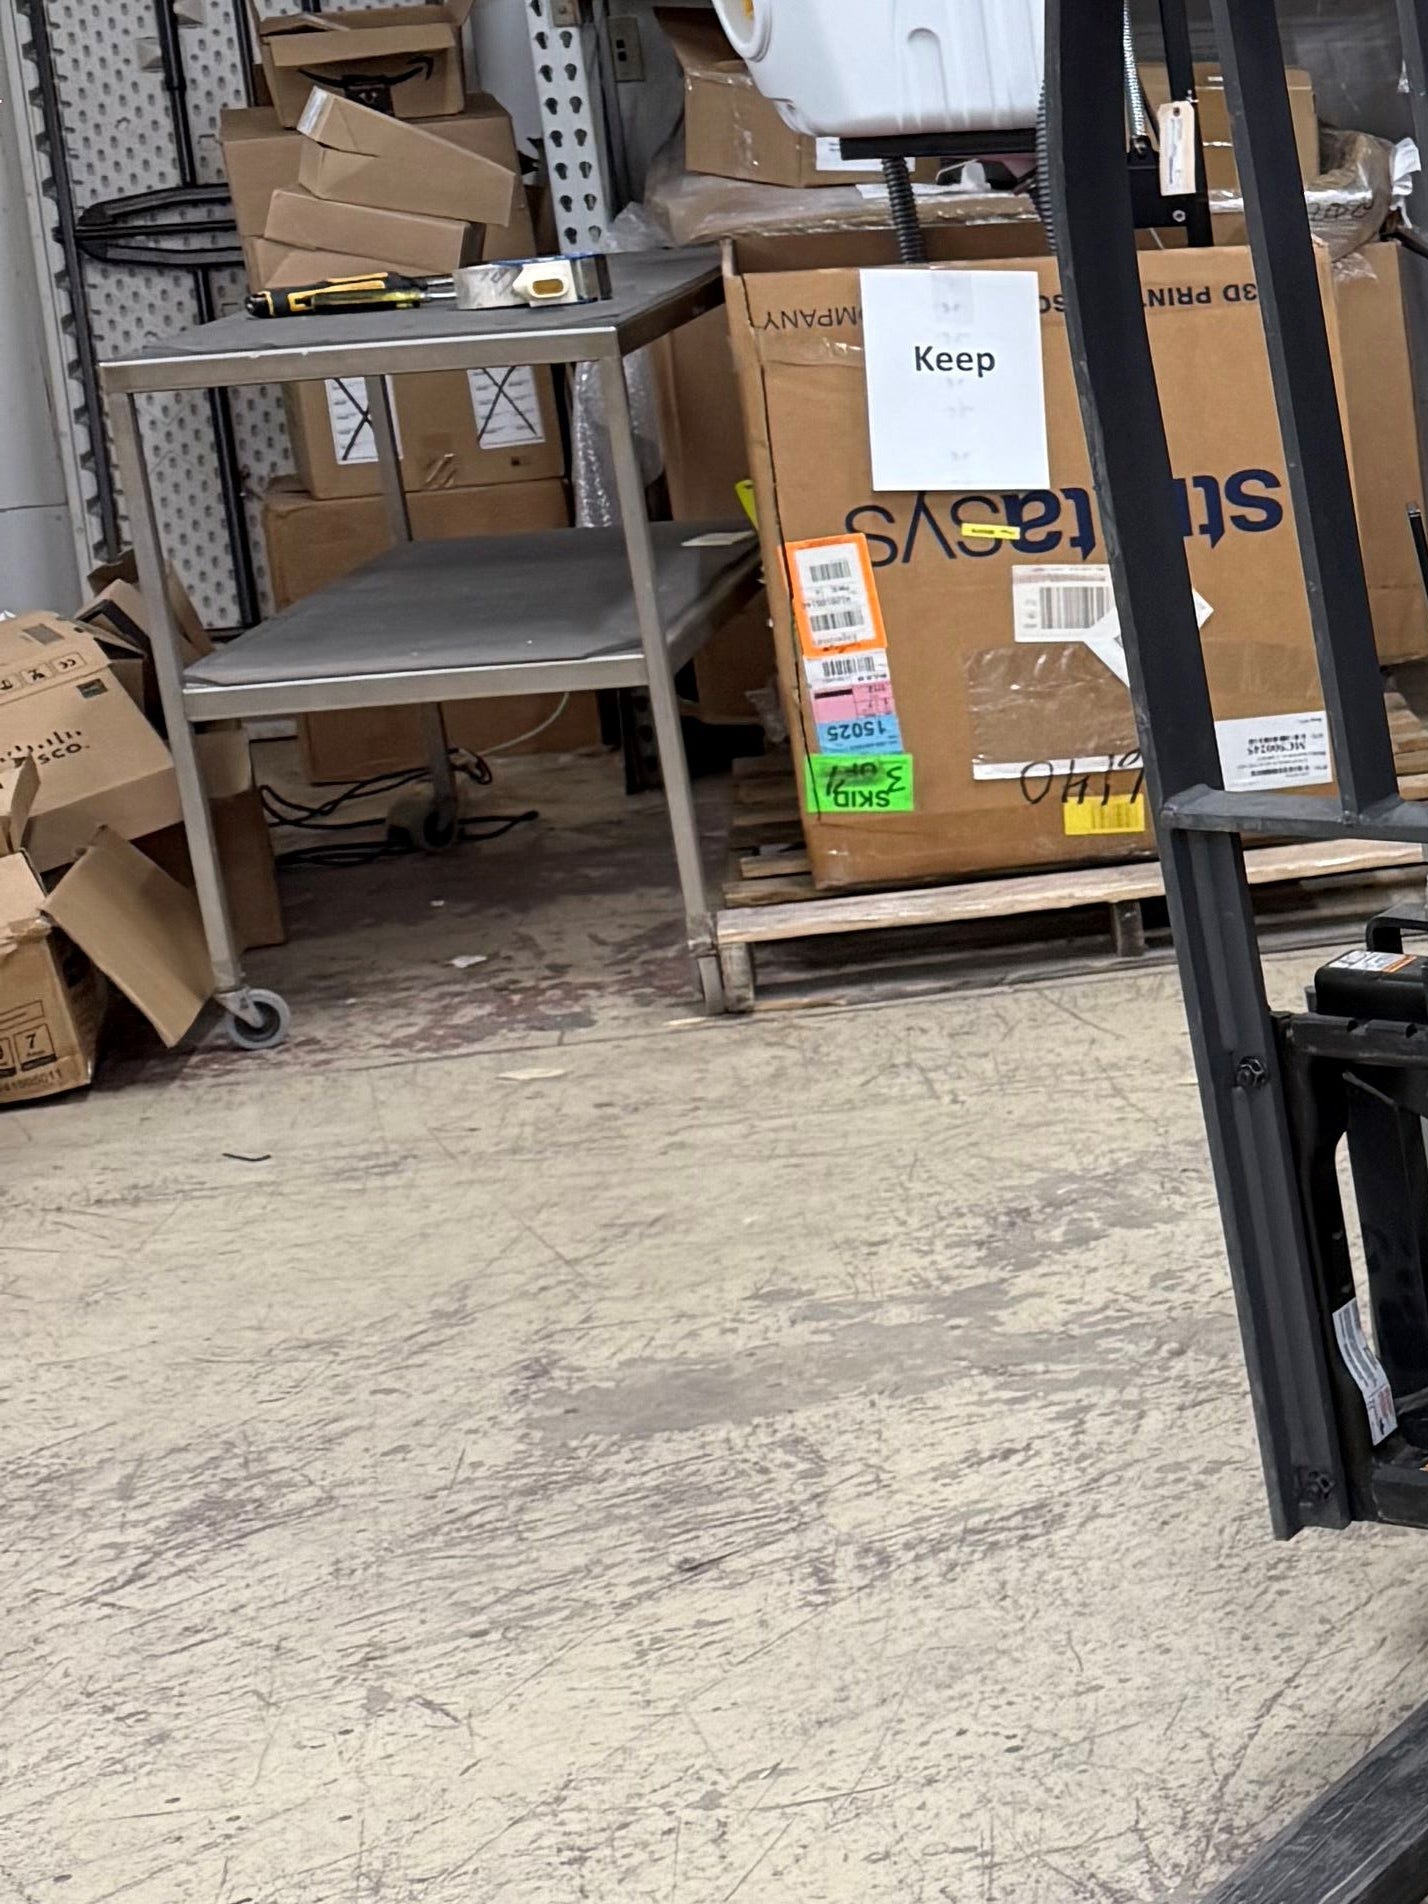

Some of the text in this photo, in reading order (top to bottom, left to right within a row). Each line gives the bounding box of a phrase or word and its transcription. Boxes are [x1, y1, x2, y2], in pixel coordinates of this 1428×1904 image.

[1223, 283, 1258, 302] 3D
[764, 305, 861, 331] MPANY
[914, 346, 996, 378] Keep
[845, 468, 1283, 568] strtasys
[827, 720, 887, 742] 15025
[833, 789, 890, 808] SKID
